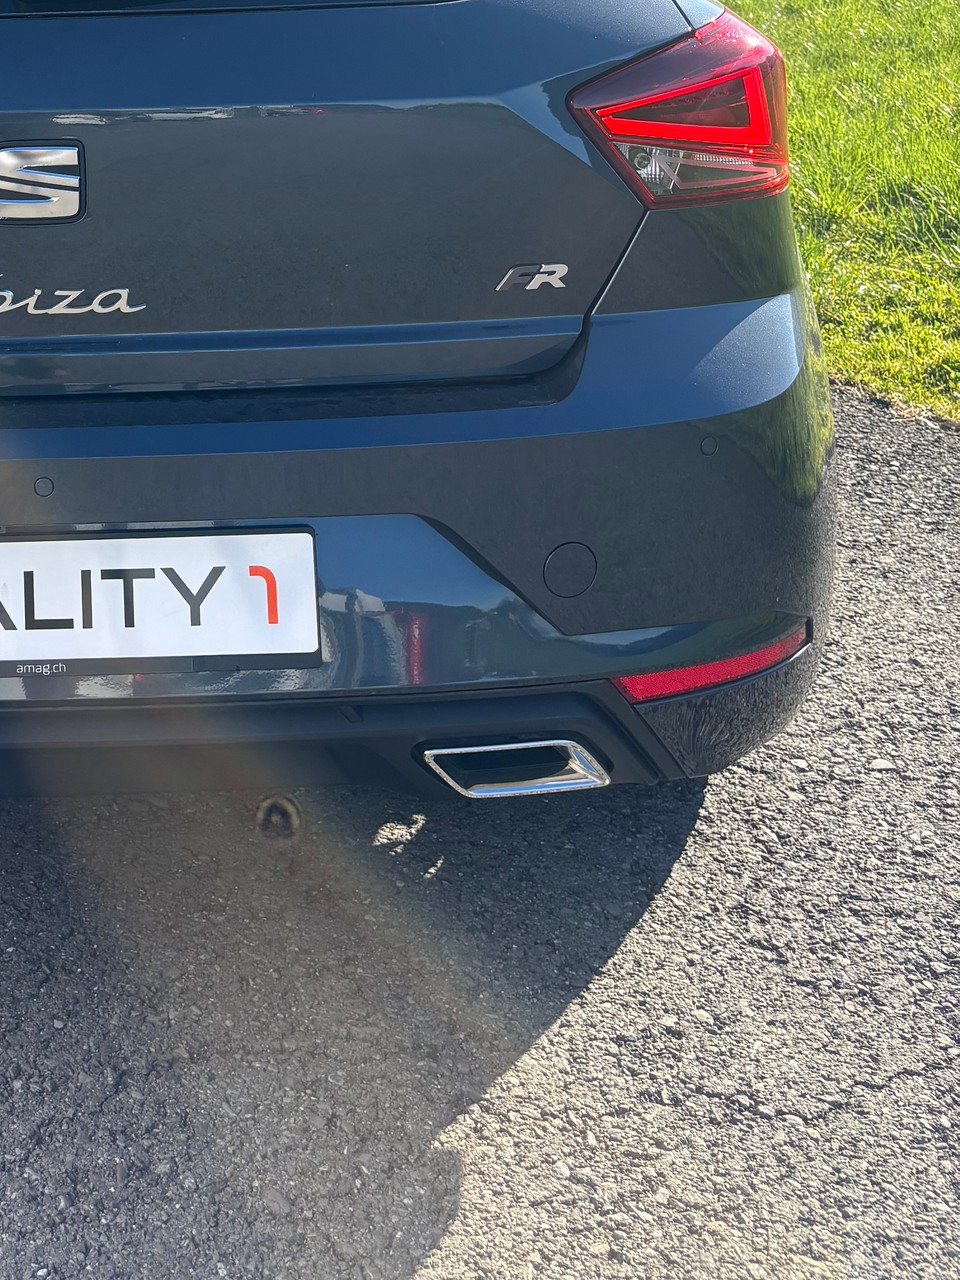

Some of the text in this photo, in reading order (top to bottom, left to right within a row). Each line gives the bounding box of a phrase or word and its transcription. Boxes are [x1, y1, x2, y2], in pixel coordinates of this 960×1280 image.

[495, 263, 569, 291] FR
[248, 565, 279, 625] 1
[16, 662, 67, 675] amag.ch
